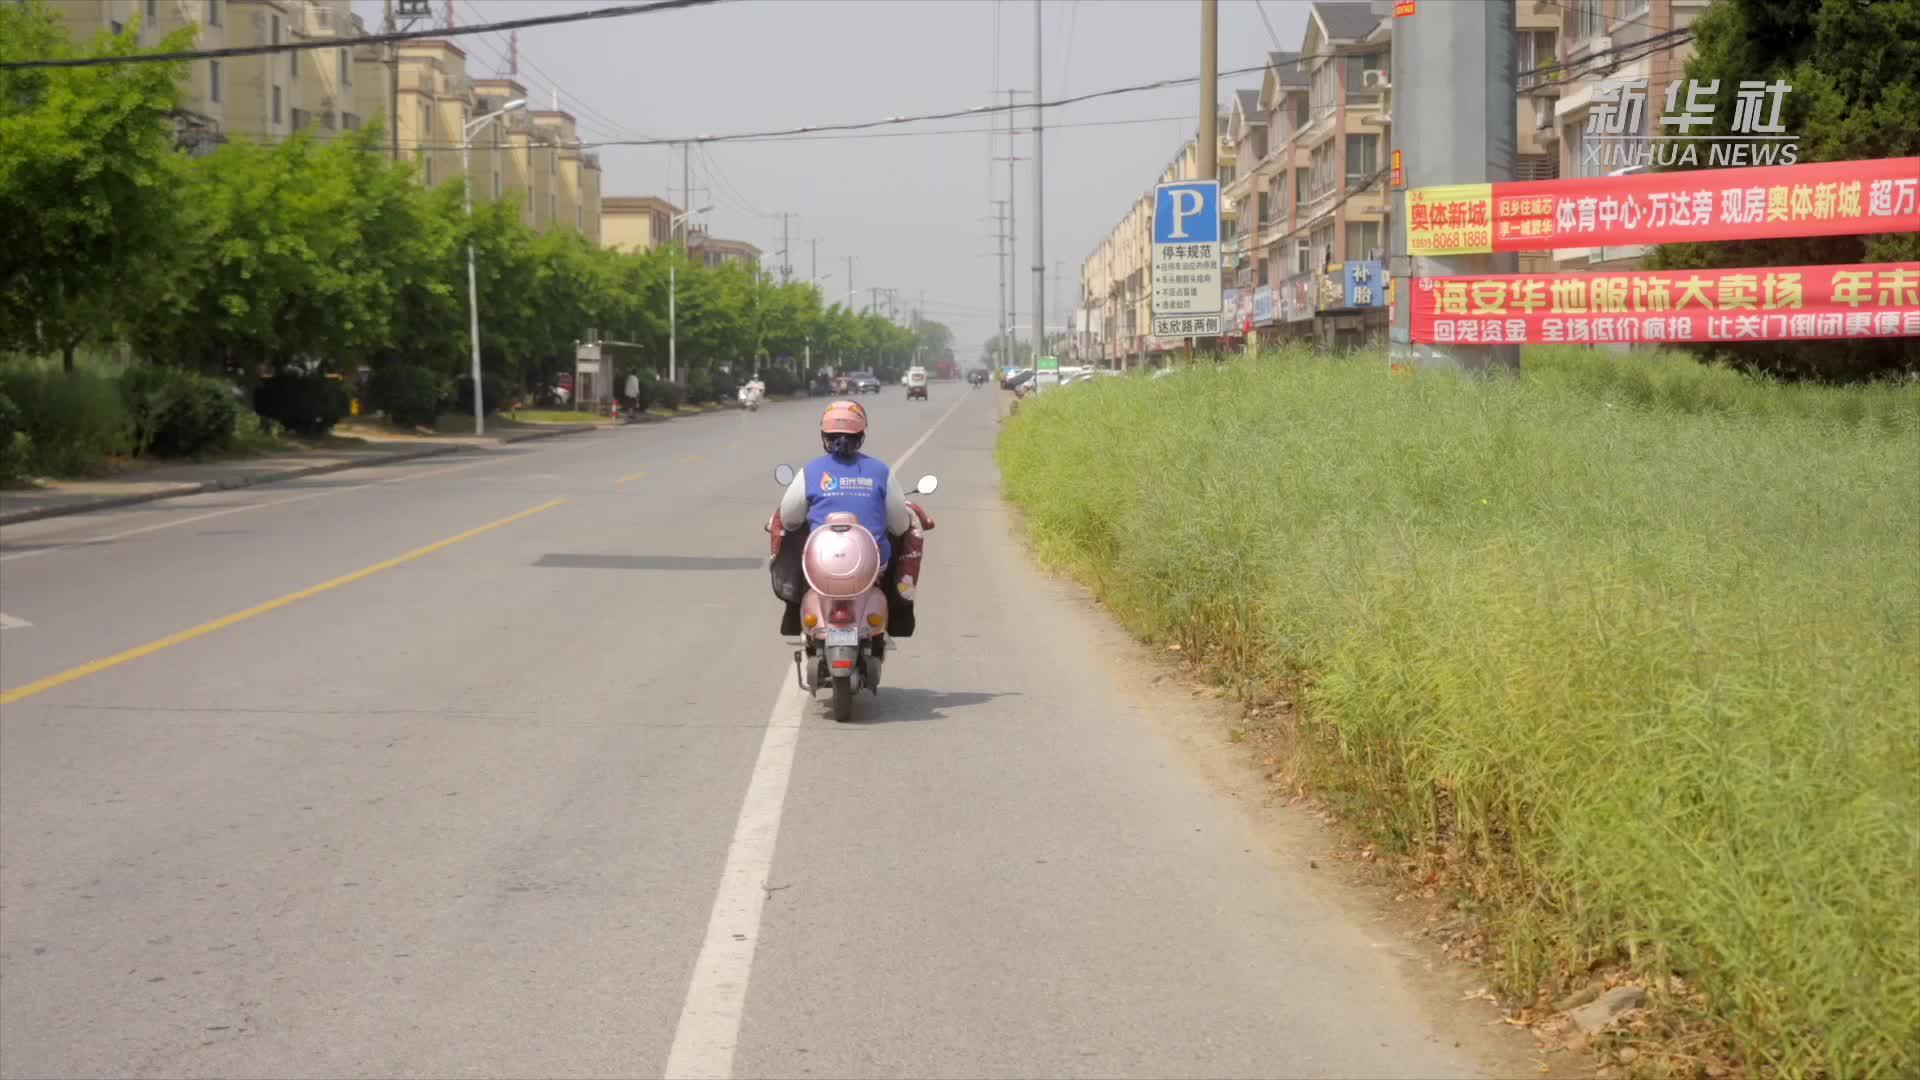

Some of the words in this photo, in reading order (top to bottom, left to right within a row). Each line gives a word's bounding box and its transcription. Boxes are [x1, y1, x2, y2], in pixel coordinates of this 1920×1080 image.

[1167, 189, 1205, 239] P
[1411, 200, 1488, 232] 奥体新城
[1720, 179, 1862, 224] 现房奥体新城
[1867, 178, 1920, 217] 超万
[1162, 244, 1212, 260] 停车规范
[1432, 273, 1803, 315] 海安华地服饰大卖场
[1830, 268, 1920, 308] 年末
[1157, 318, 1218, 334] 达欣路两侧
[1433, 318, 1528, 342] 回笼资金
[1541, 316, 1693, 342] 全场低价疯抢
[1707, 311, 1920, 340] 比关门倒闭更便宜
